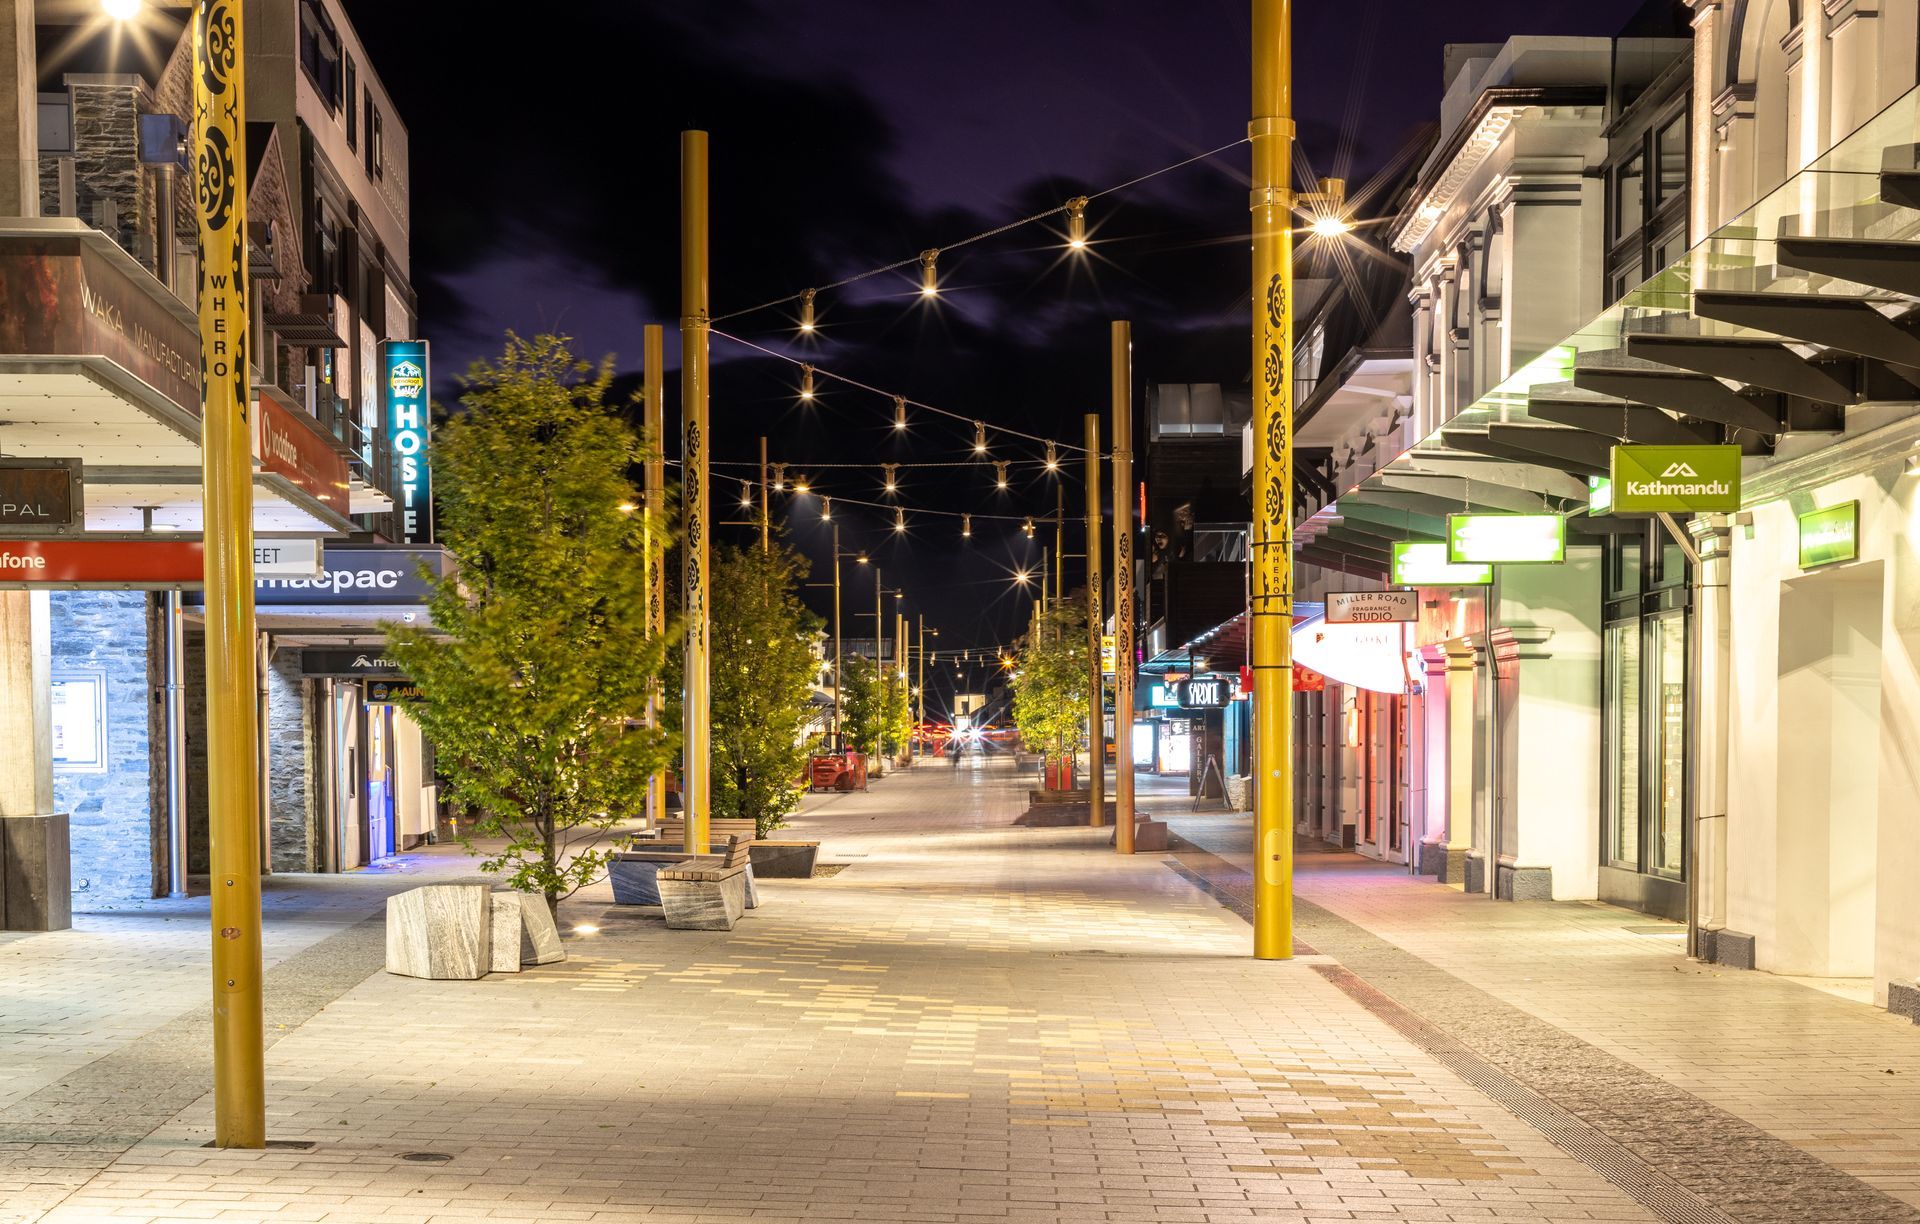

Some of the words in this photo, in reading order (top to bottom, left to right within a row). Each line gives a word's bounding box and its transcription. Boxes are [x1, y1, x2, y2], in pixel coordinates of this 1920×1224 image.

[80, 282, 125, 336] WAKA
[134, 322, 201, 391] MANUFACTURIN
[210, 275, 228, 377] WHERO
[271, 428, 298, 469] vodafone
[394, 404, 421, 544] HOSTE
[1626, 480, 1729, 496] Kathmandu
[2, 503, 50, 516] PAL
[0, 551, 46, 569] fone
[1271, 546, 1280, 594] WHERO
[1336, 593, 1373, 606] MILLER
[1377, 593, 1407, 605] ROAD
[1352, 612, 1393, 622] STUDIO
